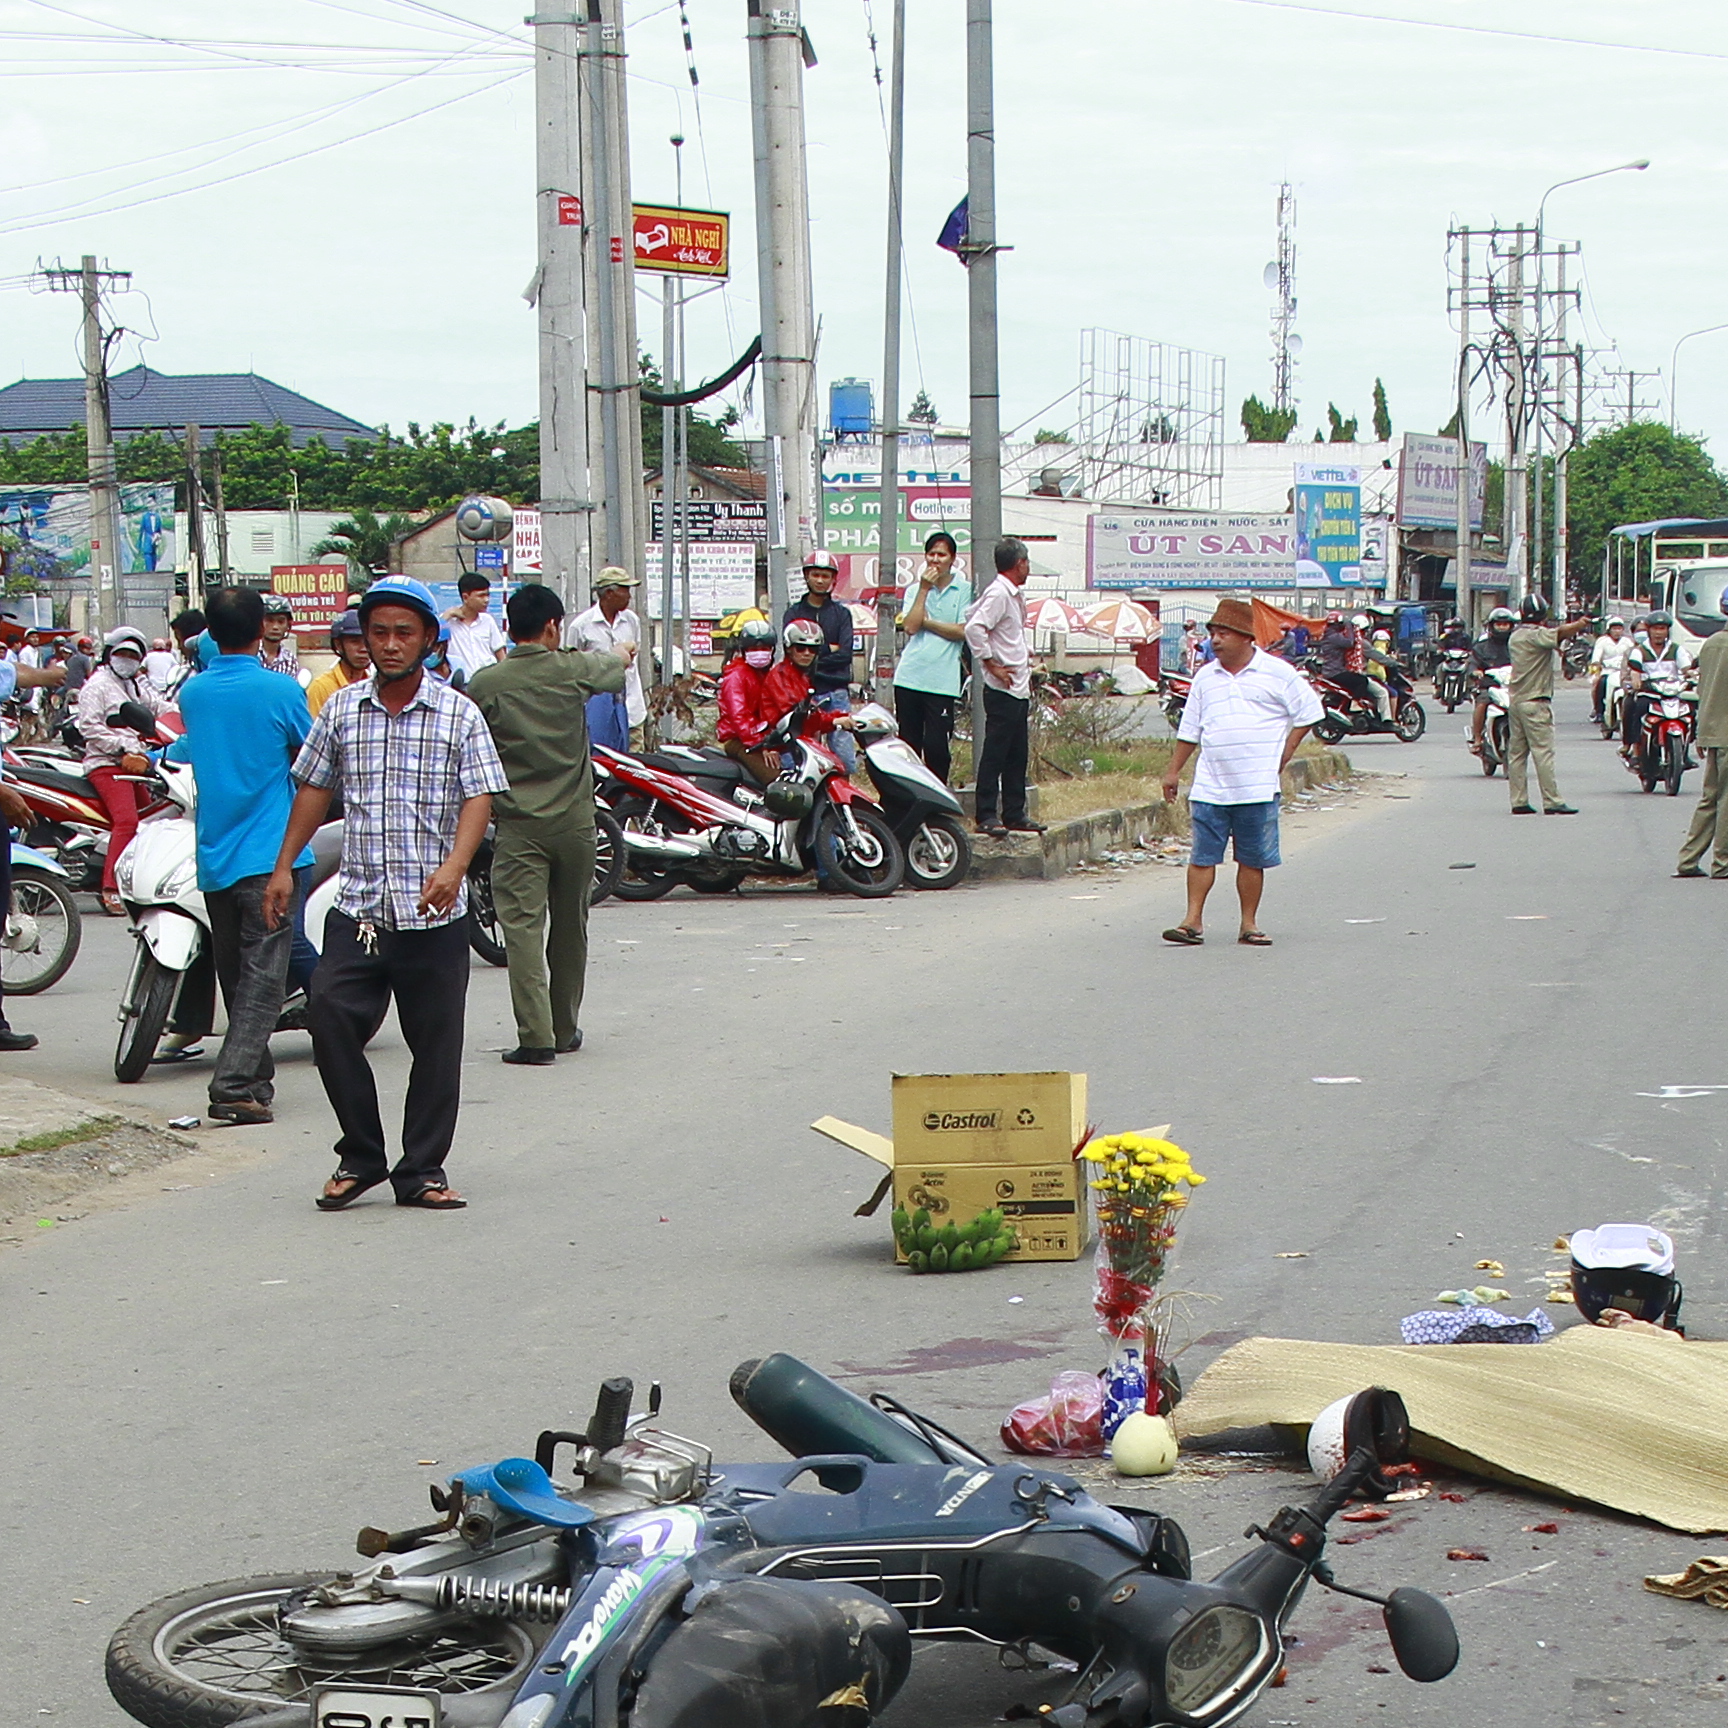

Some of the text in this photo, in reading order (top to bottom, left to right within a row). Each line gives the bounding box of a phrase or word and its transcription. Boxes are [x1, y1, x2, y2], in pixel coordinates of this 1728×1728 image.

[670, 222, 721, 250] NHÀ NGHỈ
[822, 470, 970, 484] VIETEL
[1312, 468, 1346, 481] VIETTEL
[731, 503, 764, 517] Thanh
[829, 496, 903, 515] số mi
[914, 502, 957, 515] Hotline:
[1133, 517, 1155, 528] CỬA
[1158, 517, 1188, 528] HÀNG
[516, 527, 541, 547] NHÂ
[1128, 529, 1295, 555] ÚT SAN
[534, 549, 541, 559] C
[273, 567, 345, 595] QUẢNG CÁO
[941, 1112, 996, 1129] Castrol
[592, 1567, 643, 1634] Wave
